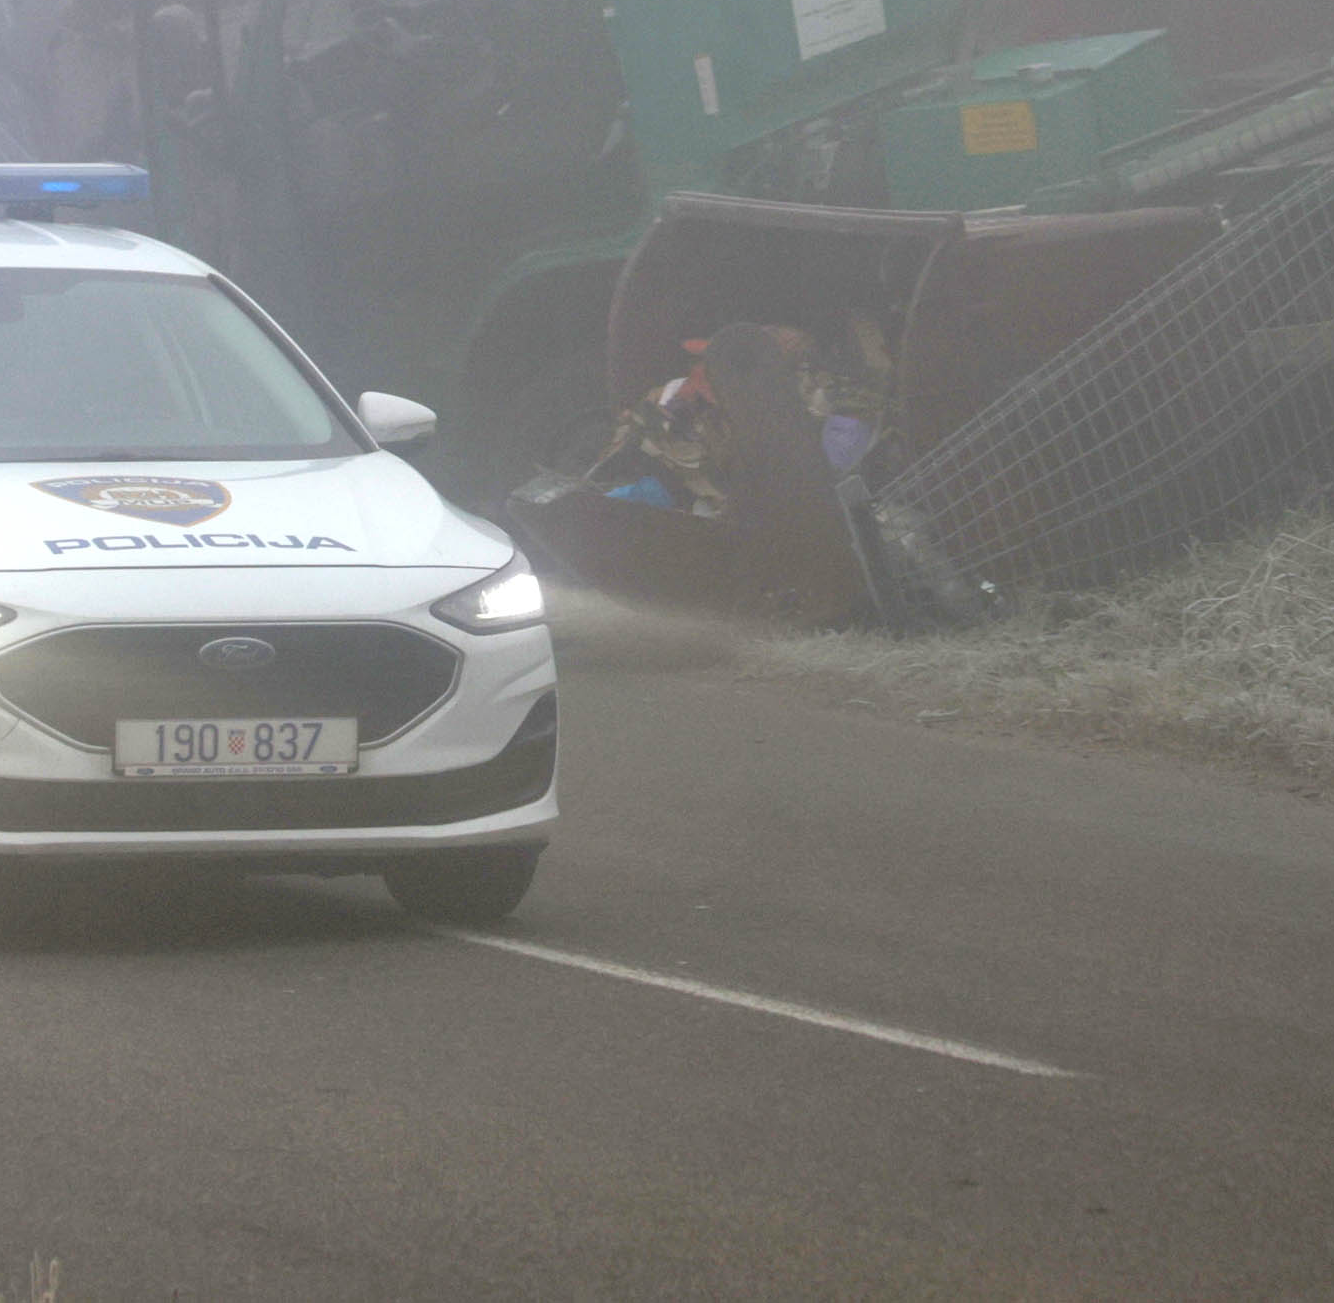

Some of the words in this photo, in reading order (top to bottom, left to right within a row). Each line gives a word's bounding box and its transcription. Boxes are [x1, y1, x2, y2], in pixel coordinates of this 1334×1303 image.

[47, 477, 212, 488] POLICIJA
[43, 533, 358, 555] POLICIJA
[155, 723, 219, 763] 190
[254, 722, 324, 763] 837
